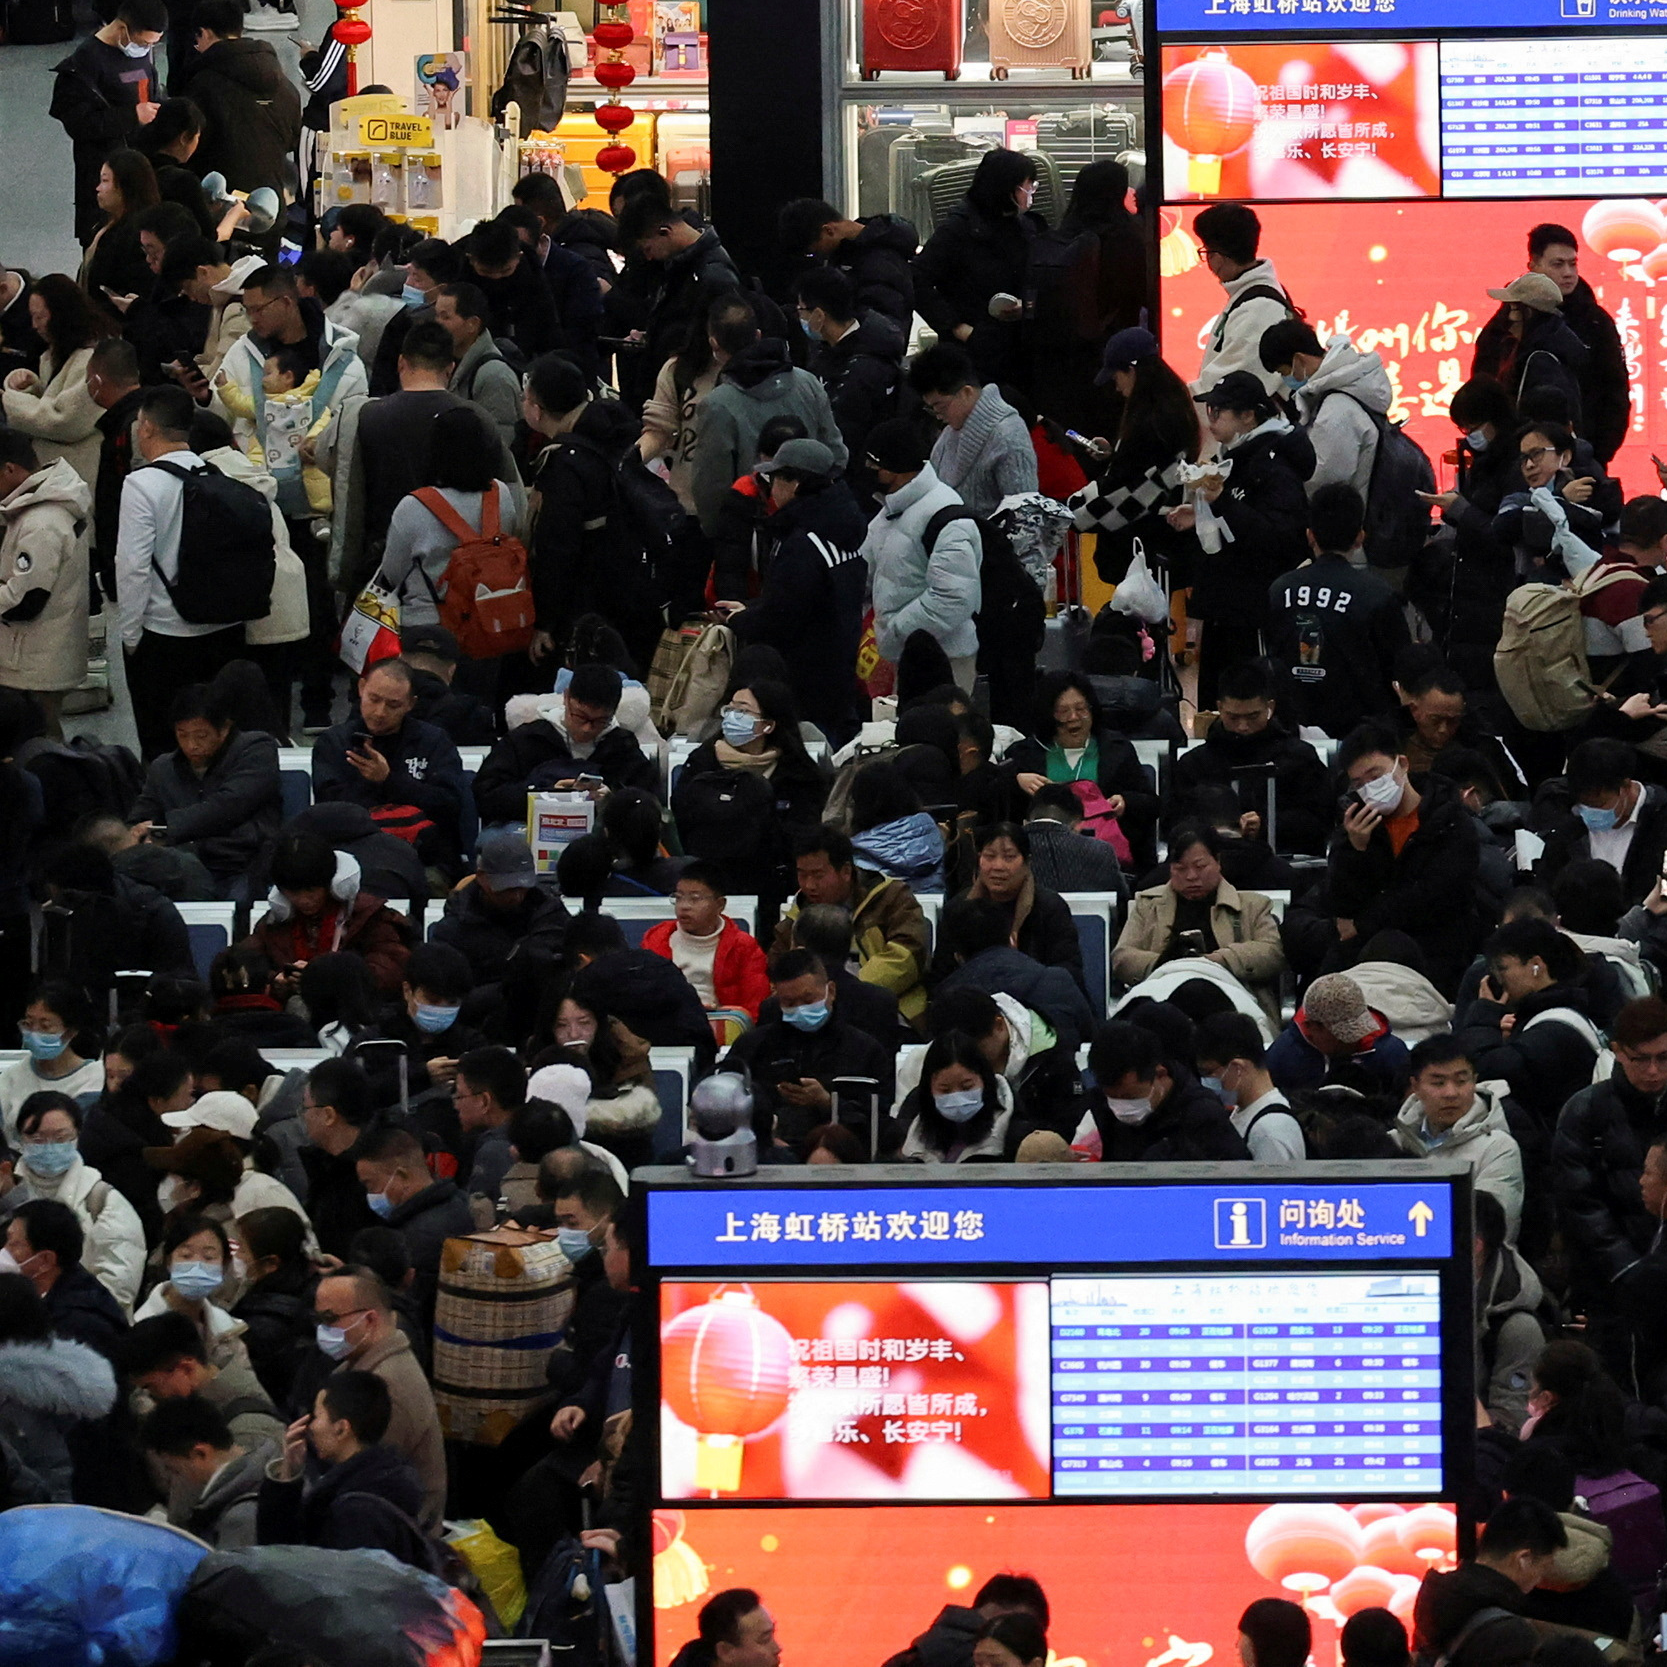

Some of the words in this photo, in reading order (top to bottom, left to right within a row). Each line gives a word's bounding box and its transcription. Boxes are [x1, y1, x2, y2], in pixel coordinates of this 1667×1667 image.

[1608, 8, 1647, 19] Drinking
[390, 122, 422, 132] TRAVEL
[390, 131, 412, 141] BLUE
[1285, 586, 1352, 613] 1992
[1279, 1198, 1366, 1230] 问询处
[715, 1210, 985, 1242] 上海虹桥站欢迎您
[1280, 1233, 1354, 1247] Information
[1356, 1232, 1406, 1246] Service
